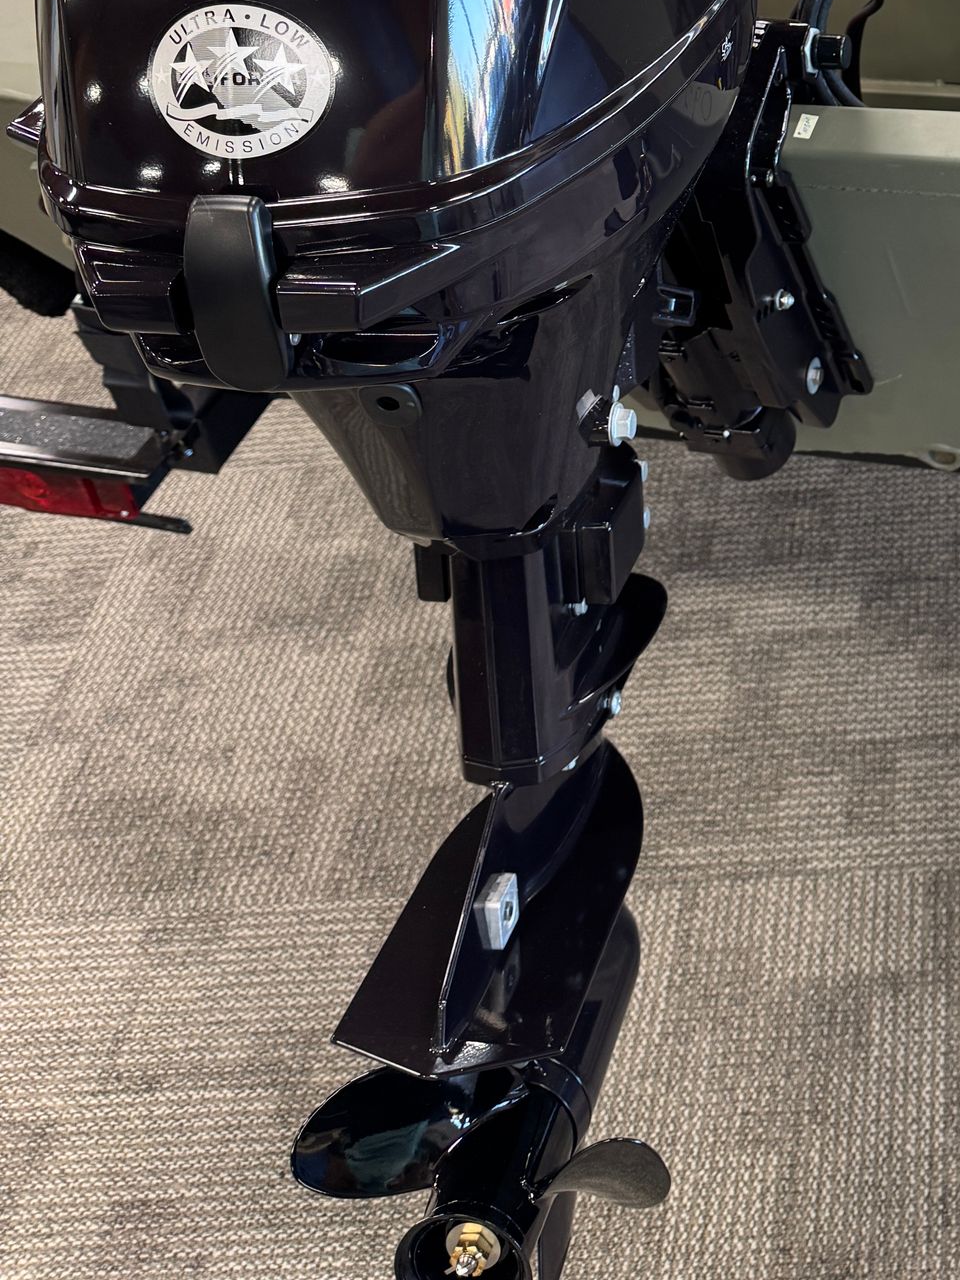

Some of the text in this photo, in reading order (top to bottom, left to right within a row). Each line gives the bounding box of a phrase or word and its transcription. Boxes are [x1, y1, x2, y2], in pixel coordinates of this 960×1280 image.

[169, 8, 310, 50] ULTRA LOW
[183, 122, 300, 154] EMISSION
